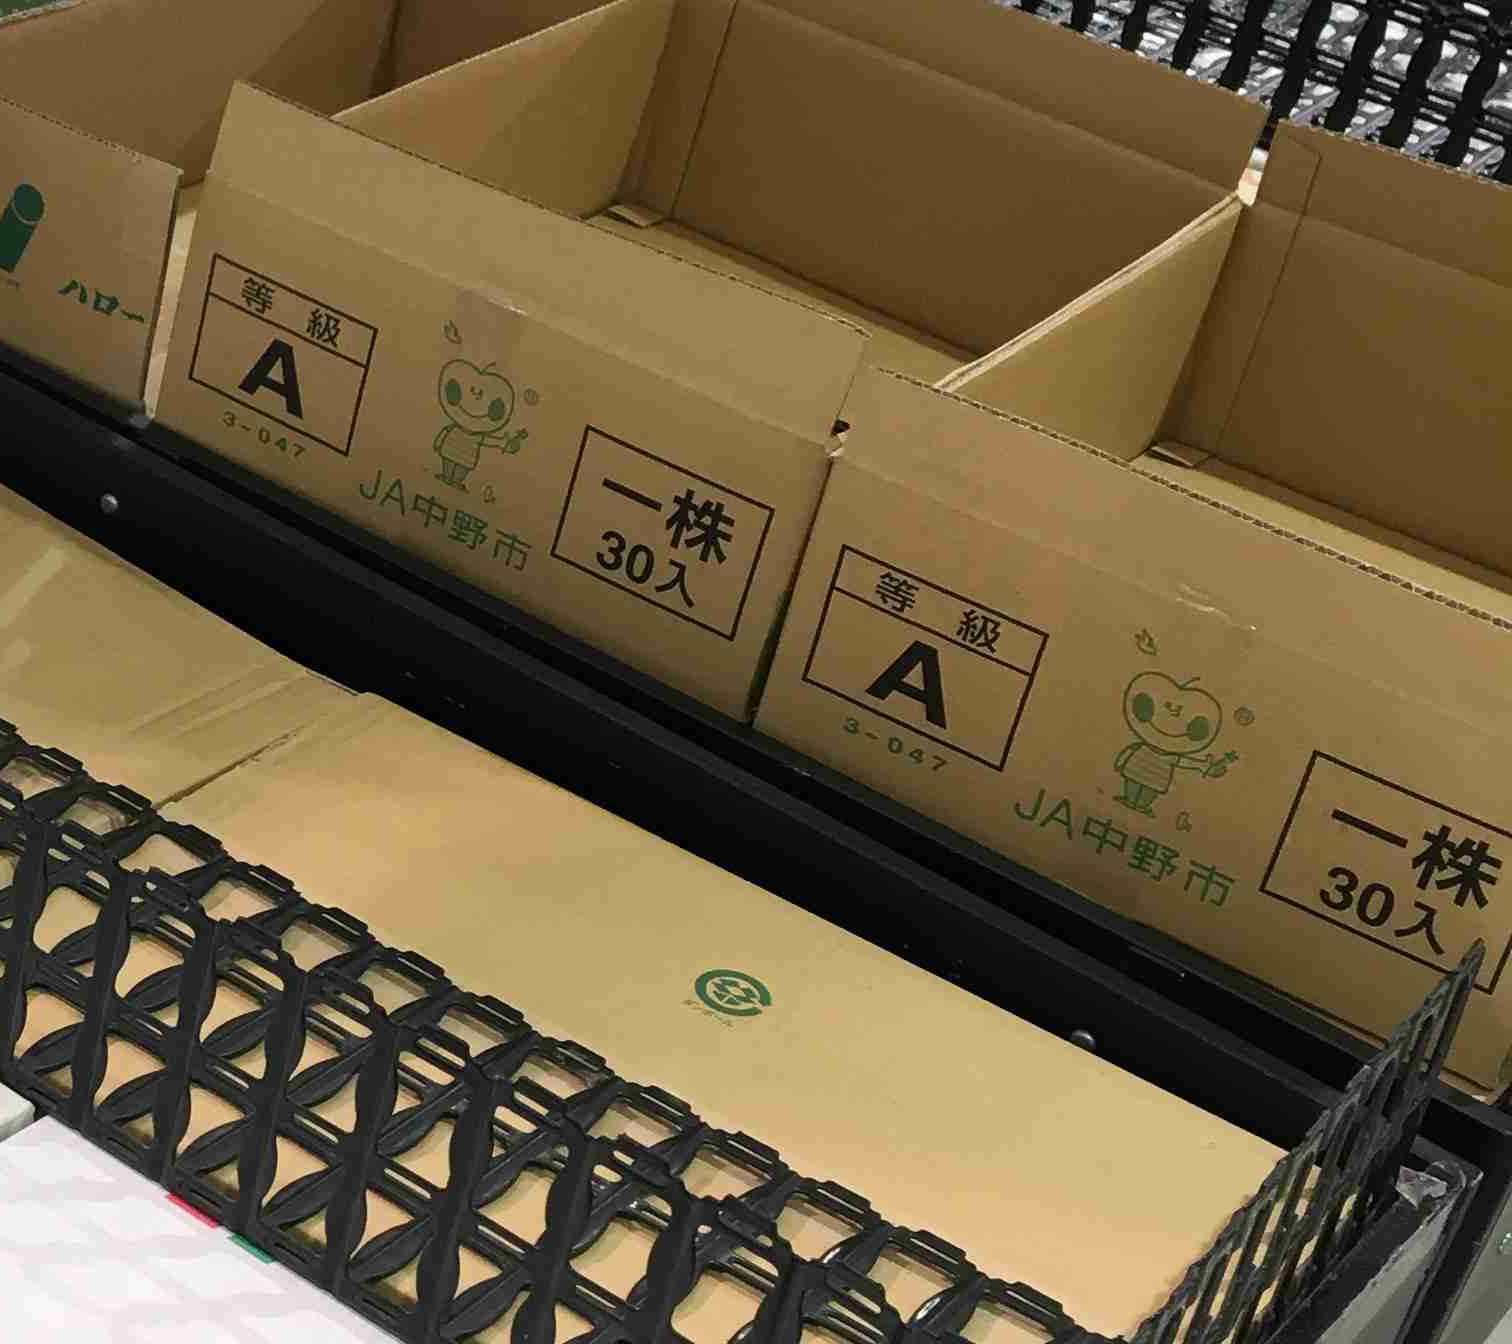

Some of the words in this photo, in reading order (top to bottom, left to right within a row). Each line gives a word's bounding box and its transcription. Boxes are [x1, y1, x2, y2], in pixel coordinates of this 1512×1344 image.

[57, 278, 145, 324] ハロー
[242, 277, 343, 348] 等級
[238, 337, 303, 419] A
[358, 470, 532, 574] JA中野市
[602, 477, 735, 565] 一株
[596, 530, 696, 608] 30入
[876, 571, 1001, 653] 等級
[865, 639, 948, 731] A
[1012, 787, 1236, 909] JA中野市
[1330, 807, 1503, 911] 一株
[1317, 865, 1447, 956] 30入
